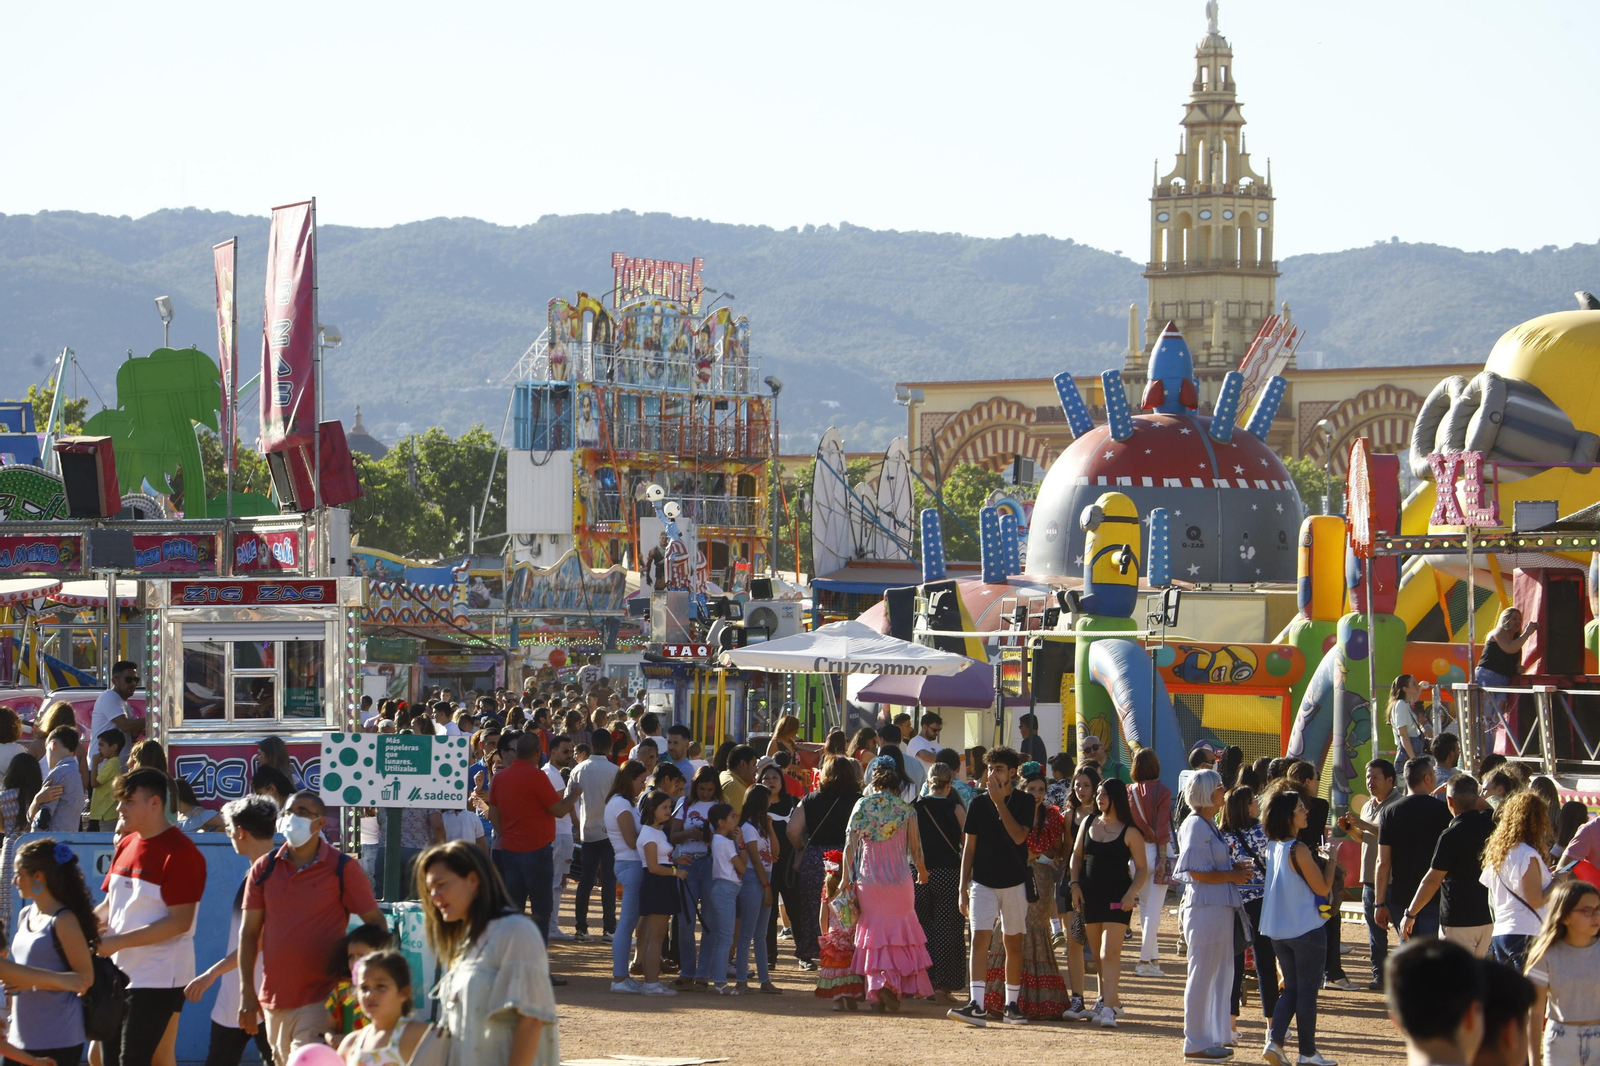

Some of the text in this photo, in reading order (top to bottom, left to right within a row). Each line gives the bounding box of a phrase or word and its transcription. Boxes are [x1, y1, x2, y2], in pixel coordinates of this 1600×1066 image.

[1426, 451, 1500, 526] XL
[12, 542, 59, 566] MENEO
[236, 537, 295, 566] DALE CAÑA
[257, 585, 324, 601] ZAG
[385, 744, 419, 752] papeleras
[424, 790, 463, 801] sadeco
